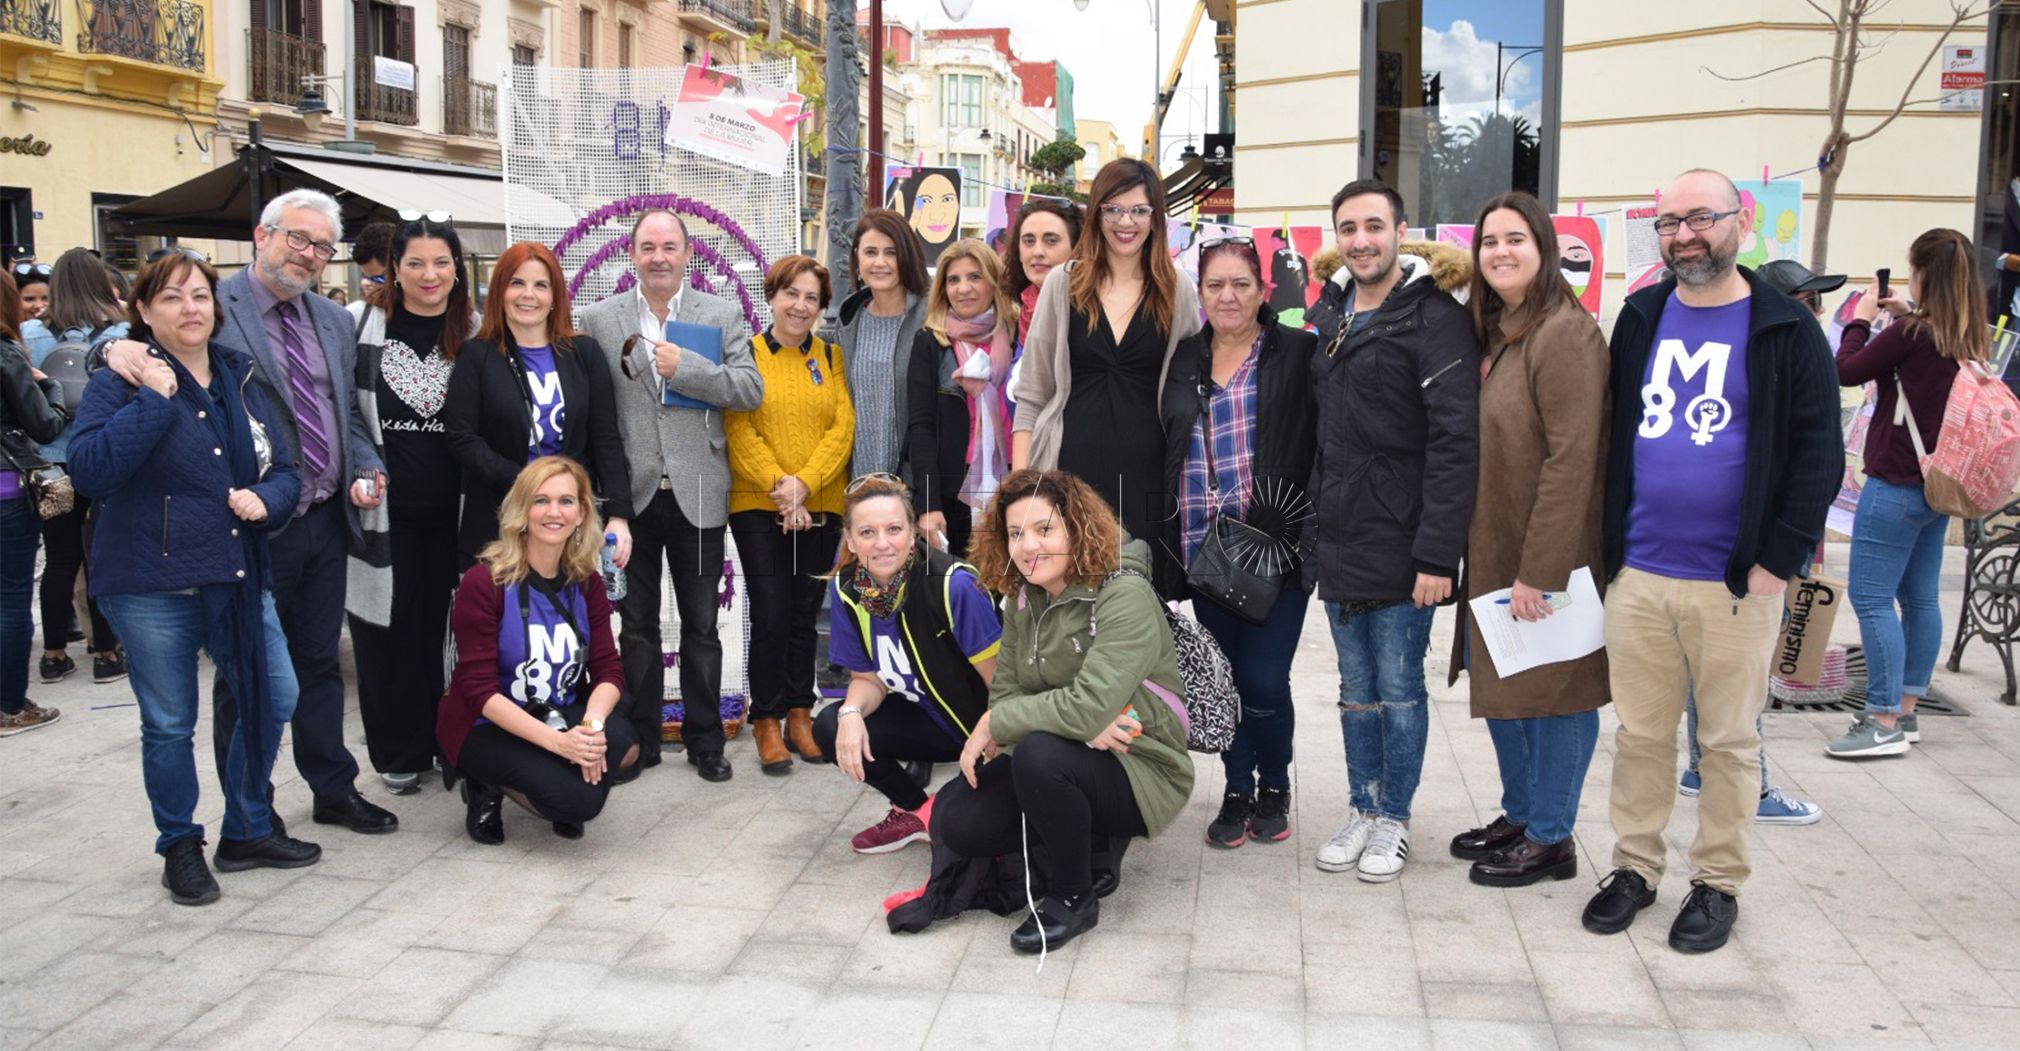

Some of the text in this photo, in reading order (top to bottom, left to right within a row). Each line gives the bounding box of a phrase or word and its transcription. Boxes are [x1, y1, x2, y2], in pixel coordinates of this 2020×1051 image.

[1943, 74, 1983, 84] Alarma
[715, 114, 728, 123] DE
[727, 117, 756, 132] MARZO
[1650, 338, 1732, 397] M
[1637, 383, 1676, 439] 8
[528, 622, 580, 664] M
[1779, 581, 1834, 676] feminismo
